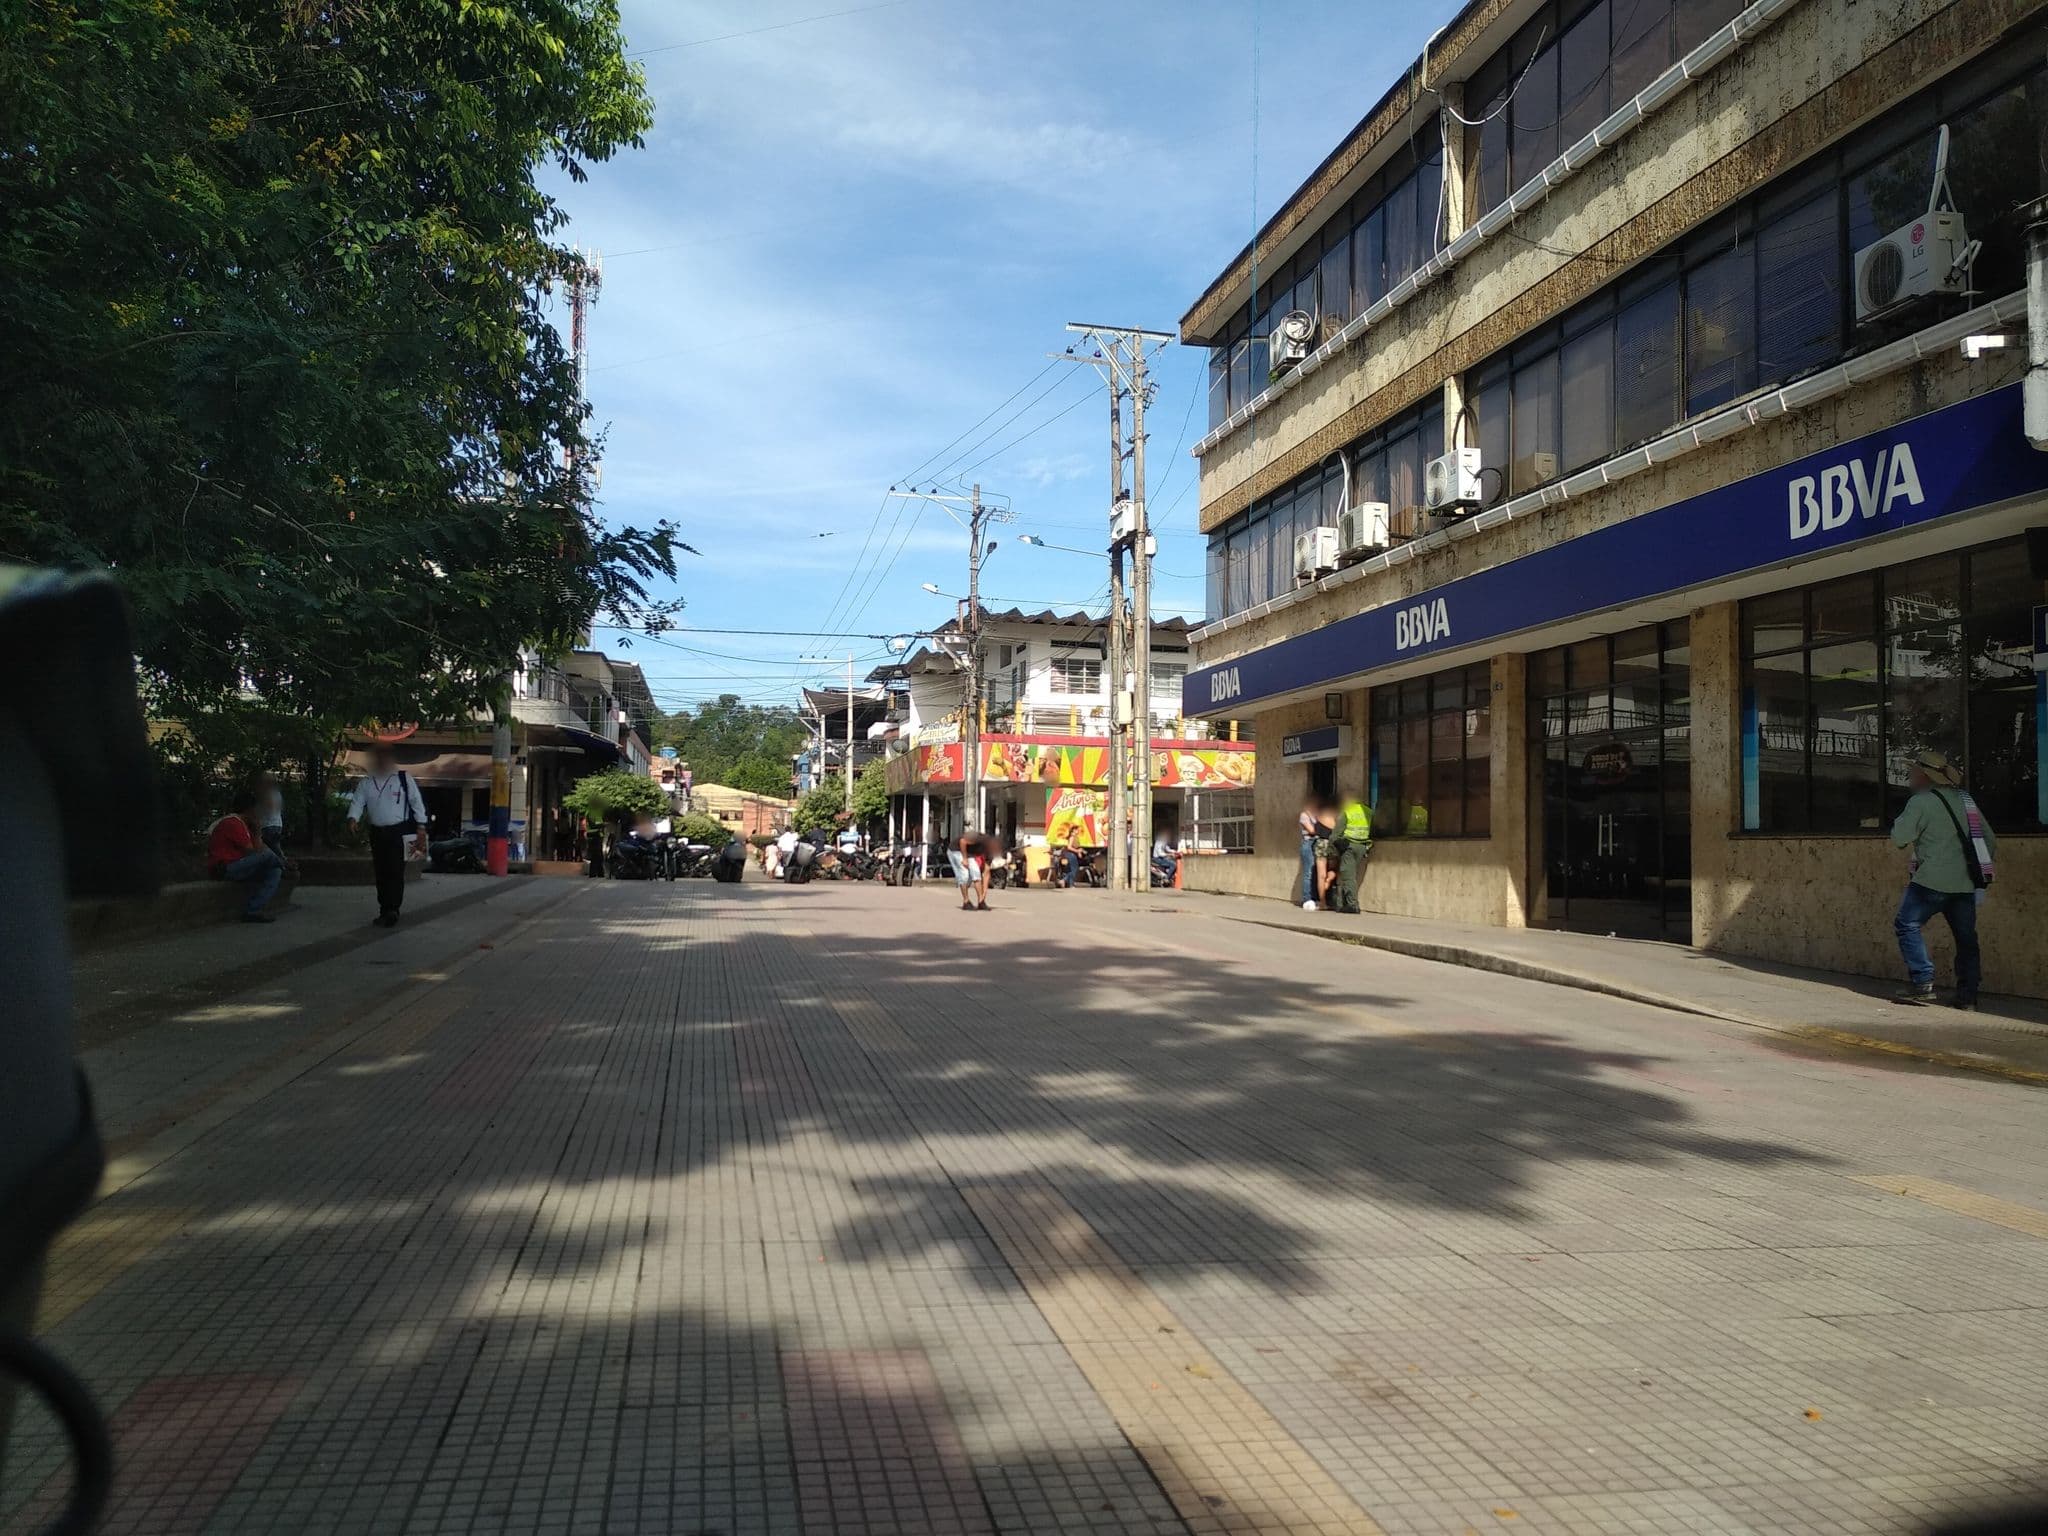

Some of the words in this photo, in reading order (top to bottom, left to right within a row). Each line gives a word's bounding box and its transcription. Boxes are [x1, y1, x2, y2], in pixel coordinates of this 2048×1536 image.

[1912, 244, 1924, 259] LG
[1788, 442, 1925, 540] BBVA
[1395, 597, 1450, 650] BBVA
[1211, 666, 1241, 703] BBVA
[1283, 736, 1301, 754] BBVA
